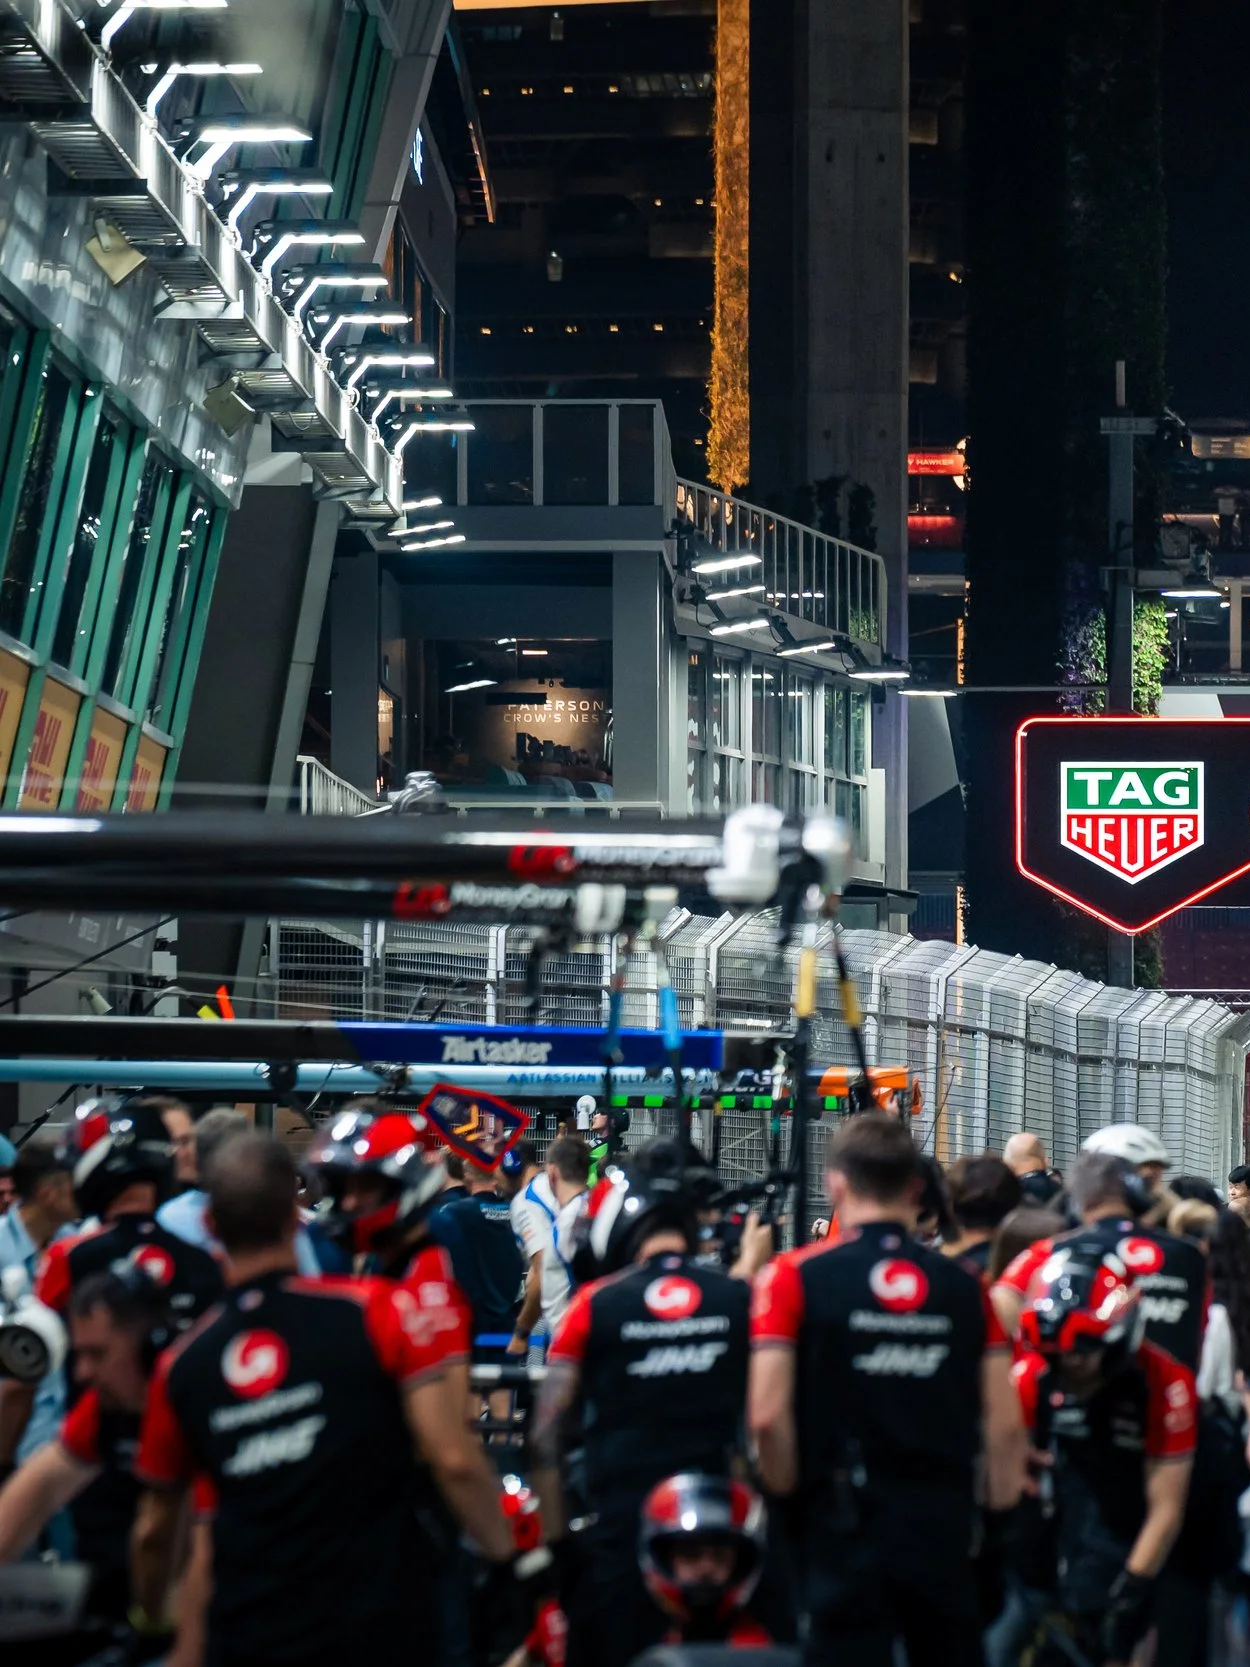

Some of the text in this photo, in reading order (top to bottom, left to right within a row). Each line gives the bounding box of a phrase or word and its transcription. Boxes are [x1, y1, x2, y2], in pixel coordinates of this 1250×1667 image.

[504, 713, 562, 723] CROW'S
[1074, 771, 1190, 805] TAG
[1071, 818, 1194, 873] HEUER
